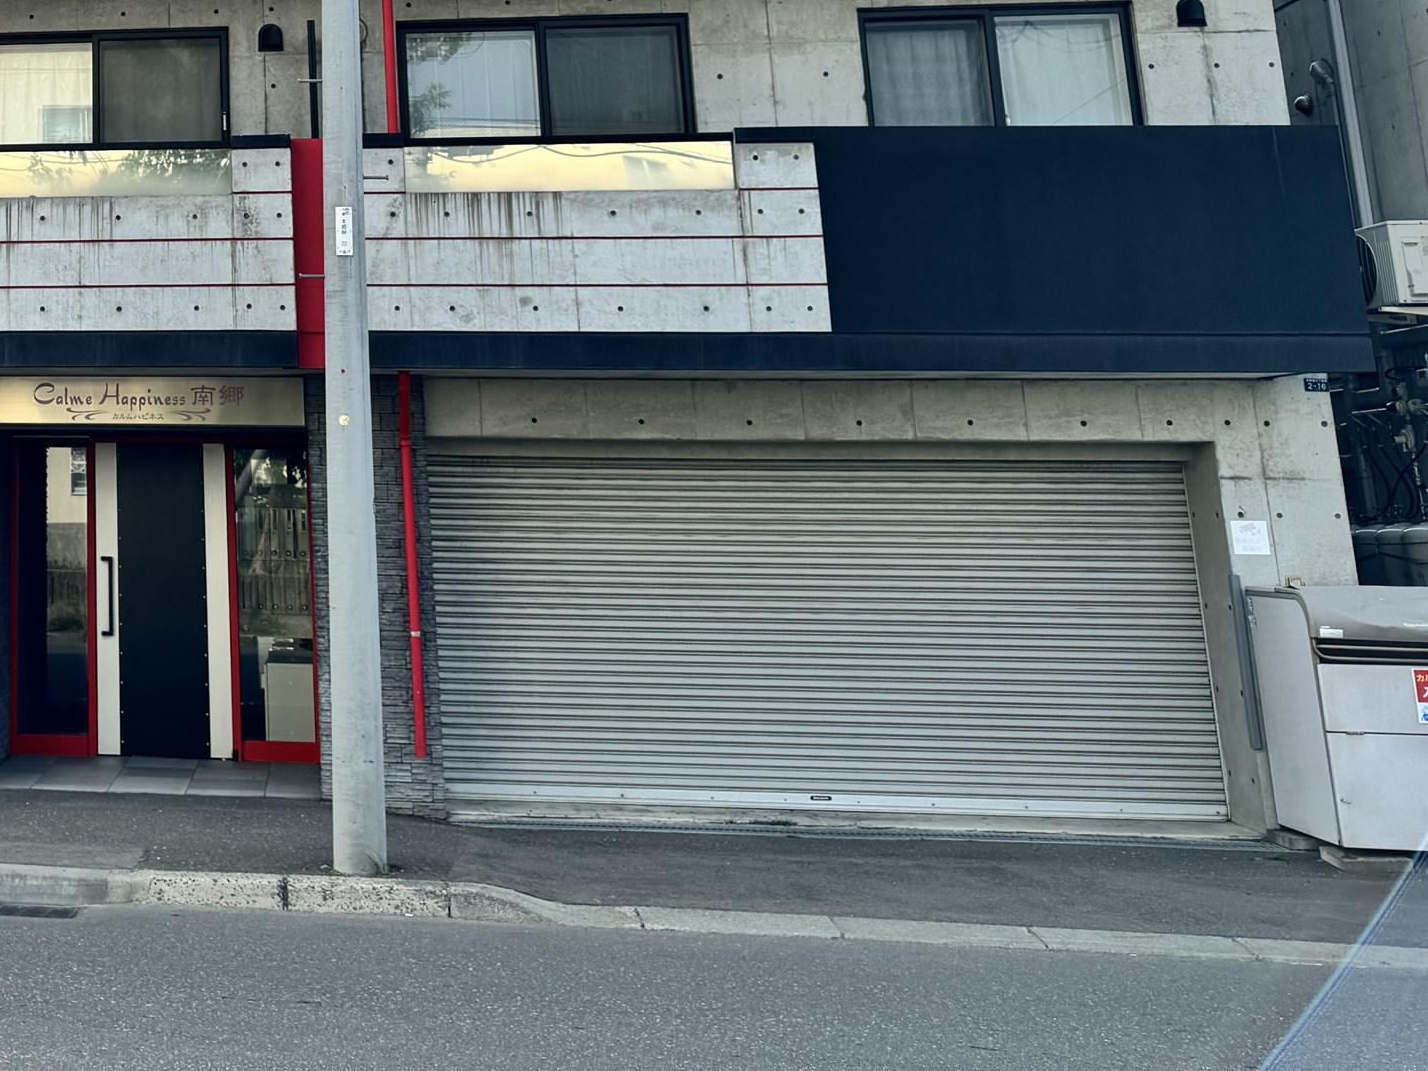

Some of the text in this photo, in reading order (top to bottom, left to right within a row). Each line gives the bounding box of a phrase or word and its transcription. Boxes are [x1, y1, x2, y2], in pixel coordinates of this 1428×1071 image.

[33, 381, 245, 411] Calme Happiness 南郷
